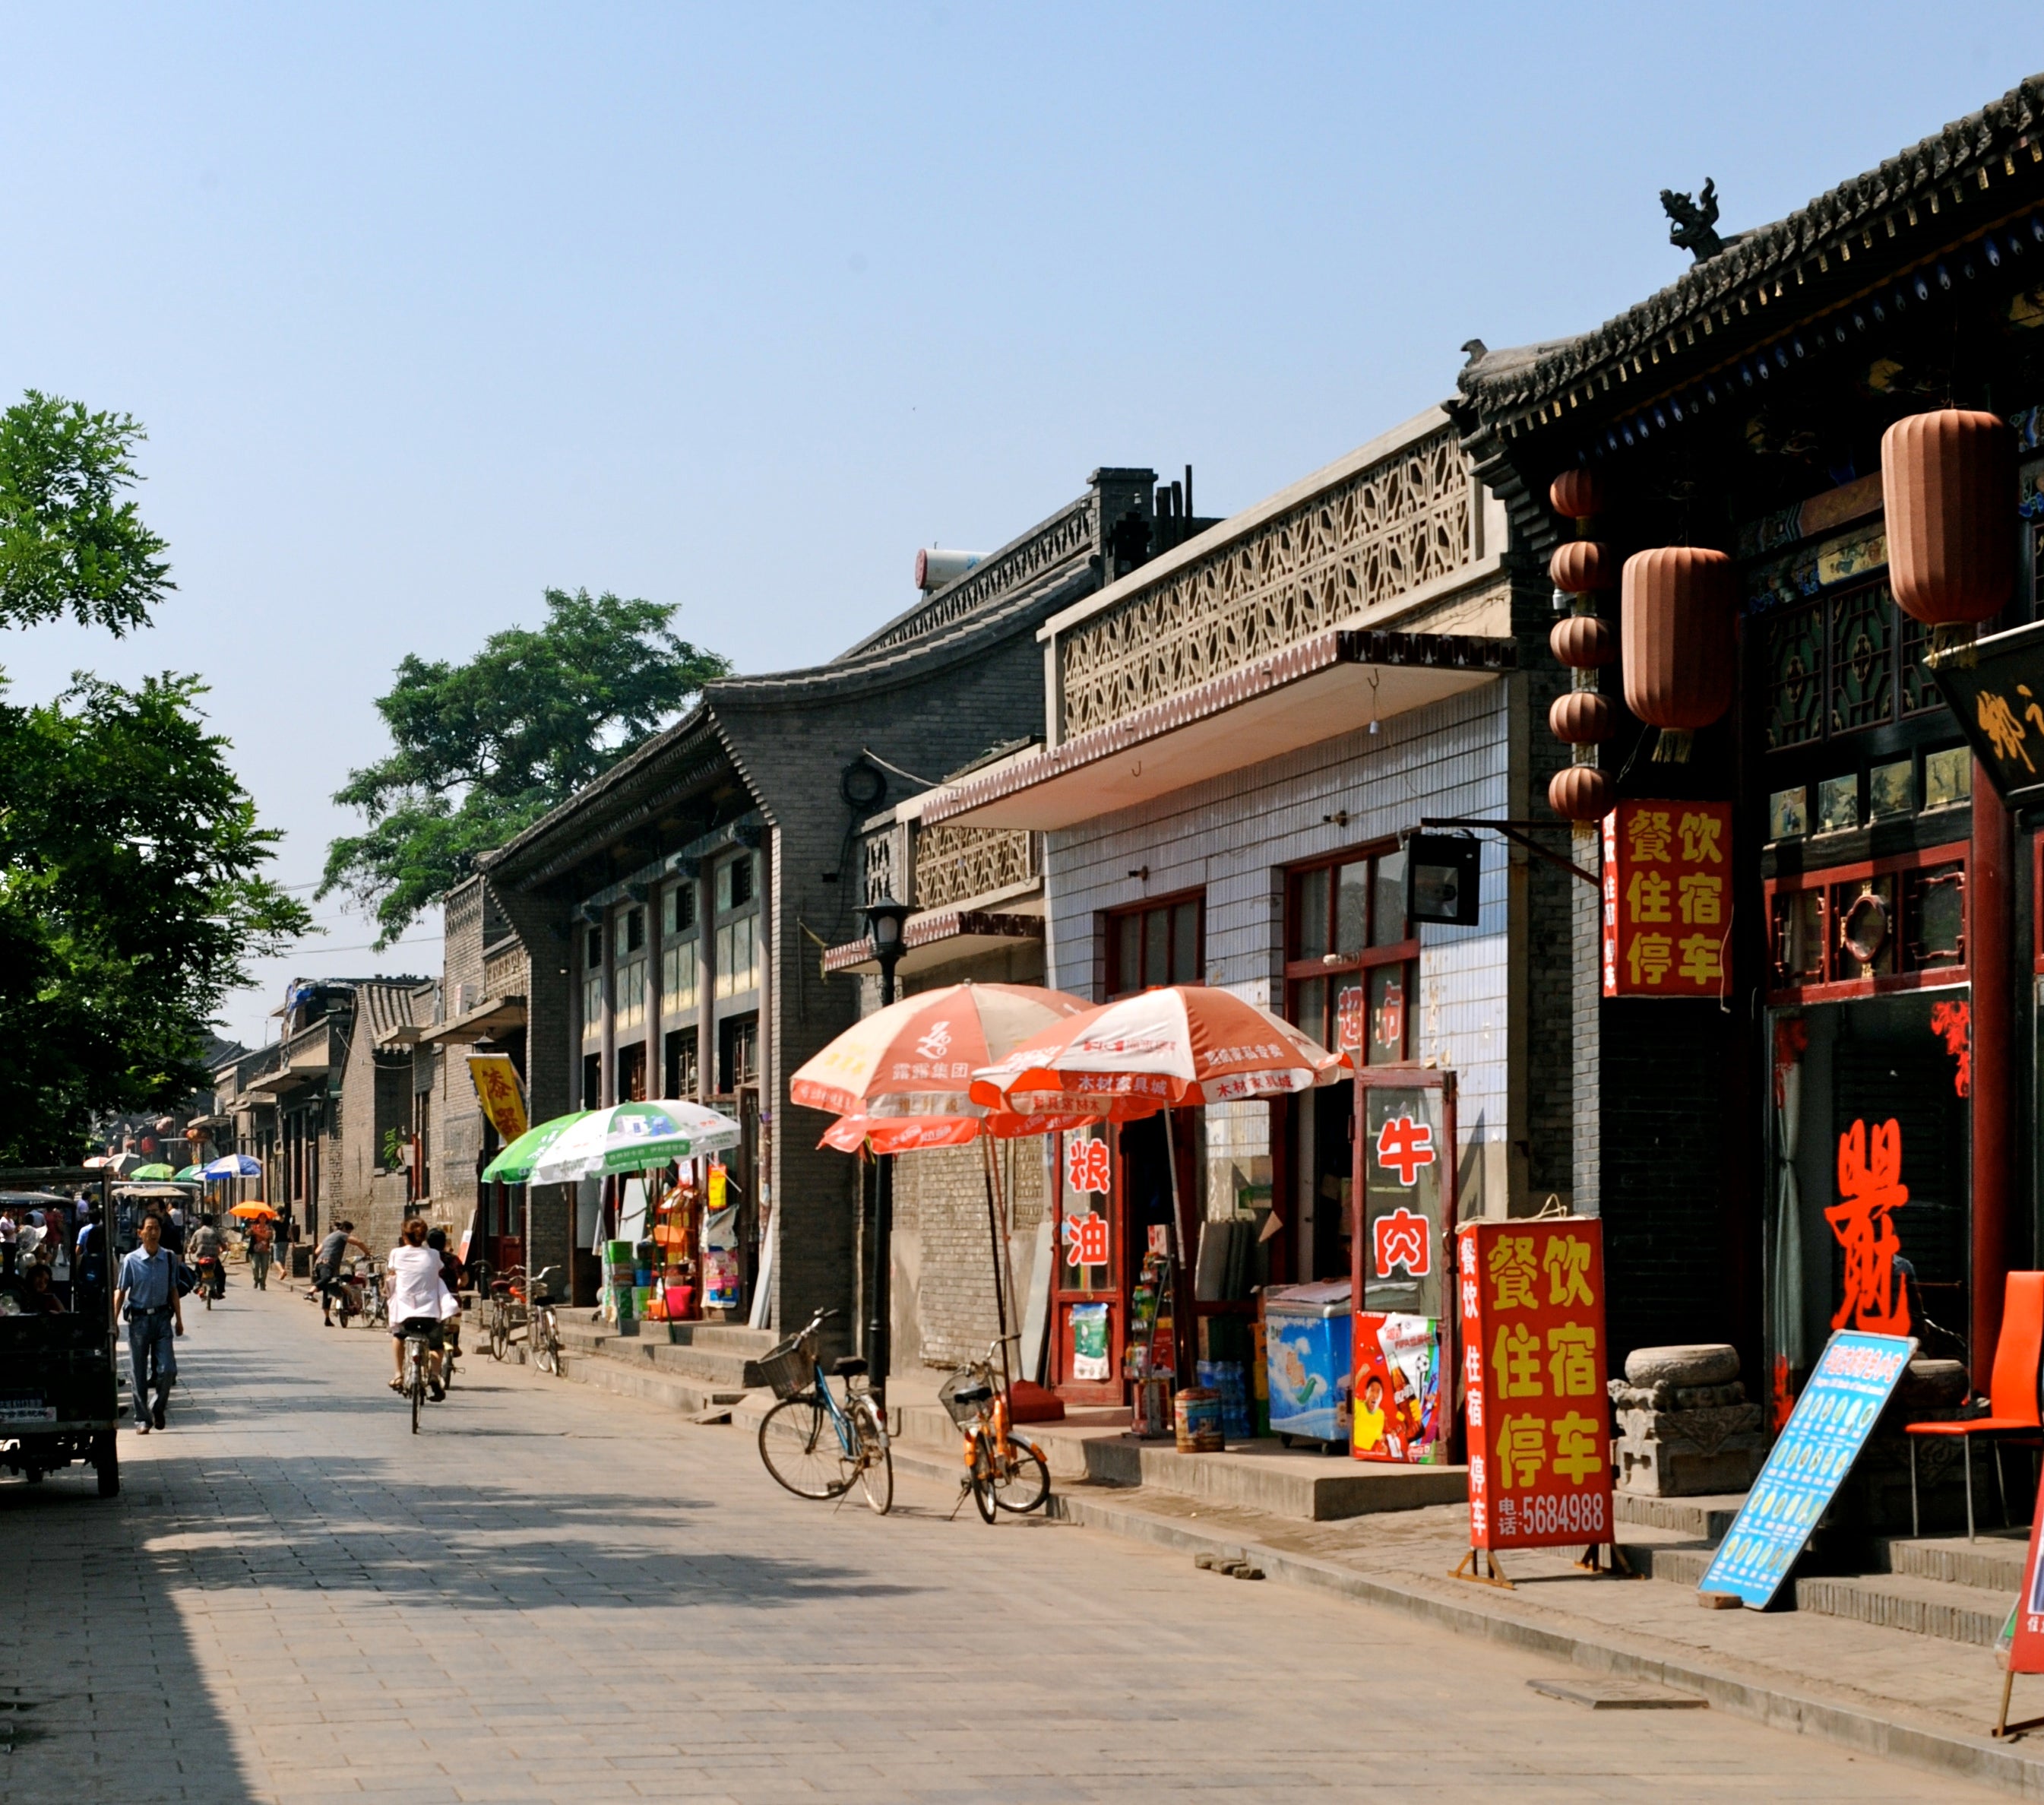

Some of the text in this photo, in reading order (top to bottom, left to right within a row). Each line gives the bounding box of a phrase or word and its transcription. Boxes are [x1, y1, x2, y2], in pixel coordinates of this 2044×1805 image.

[1627, 809, 1723, 863] 餐饮
[1627, 871, 1722, 924] 住宿
[1627, 933, 1723, 984] 停车
[1337, 980, 1401, 1053] 超市
[893, 1062, 969, 1080] 露露集团
[1079, 1075, 1168, 1095] 木材家具城
[1217, 1074, 1294, 1097] 木材家具城
[1067, 1138, 1110, 1266] 粮油
[1373, 1116, 1435, 1278] 牛肉
[1488, 1234, 1593, 1310] 餐饮
[1460, 1237, 1486, 1536] 餐饮 住宿 停车
[1492, 1322, 1596, 1399] 住宿
[1496, 1411, 1602, 1489] 停车
[1524, 1493, 1603, 1534] 5684988
